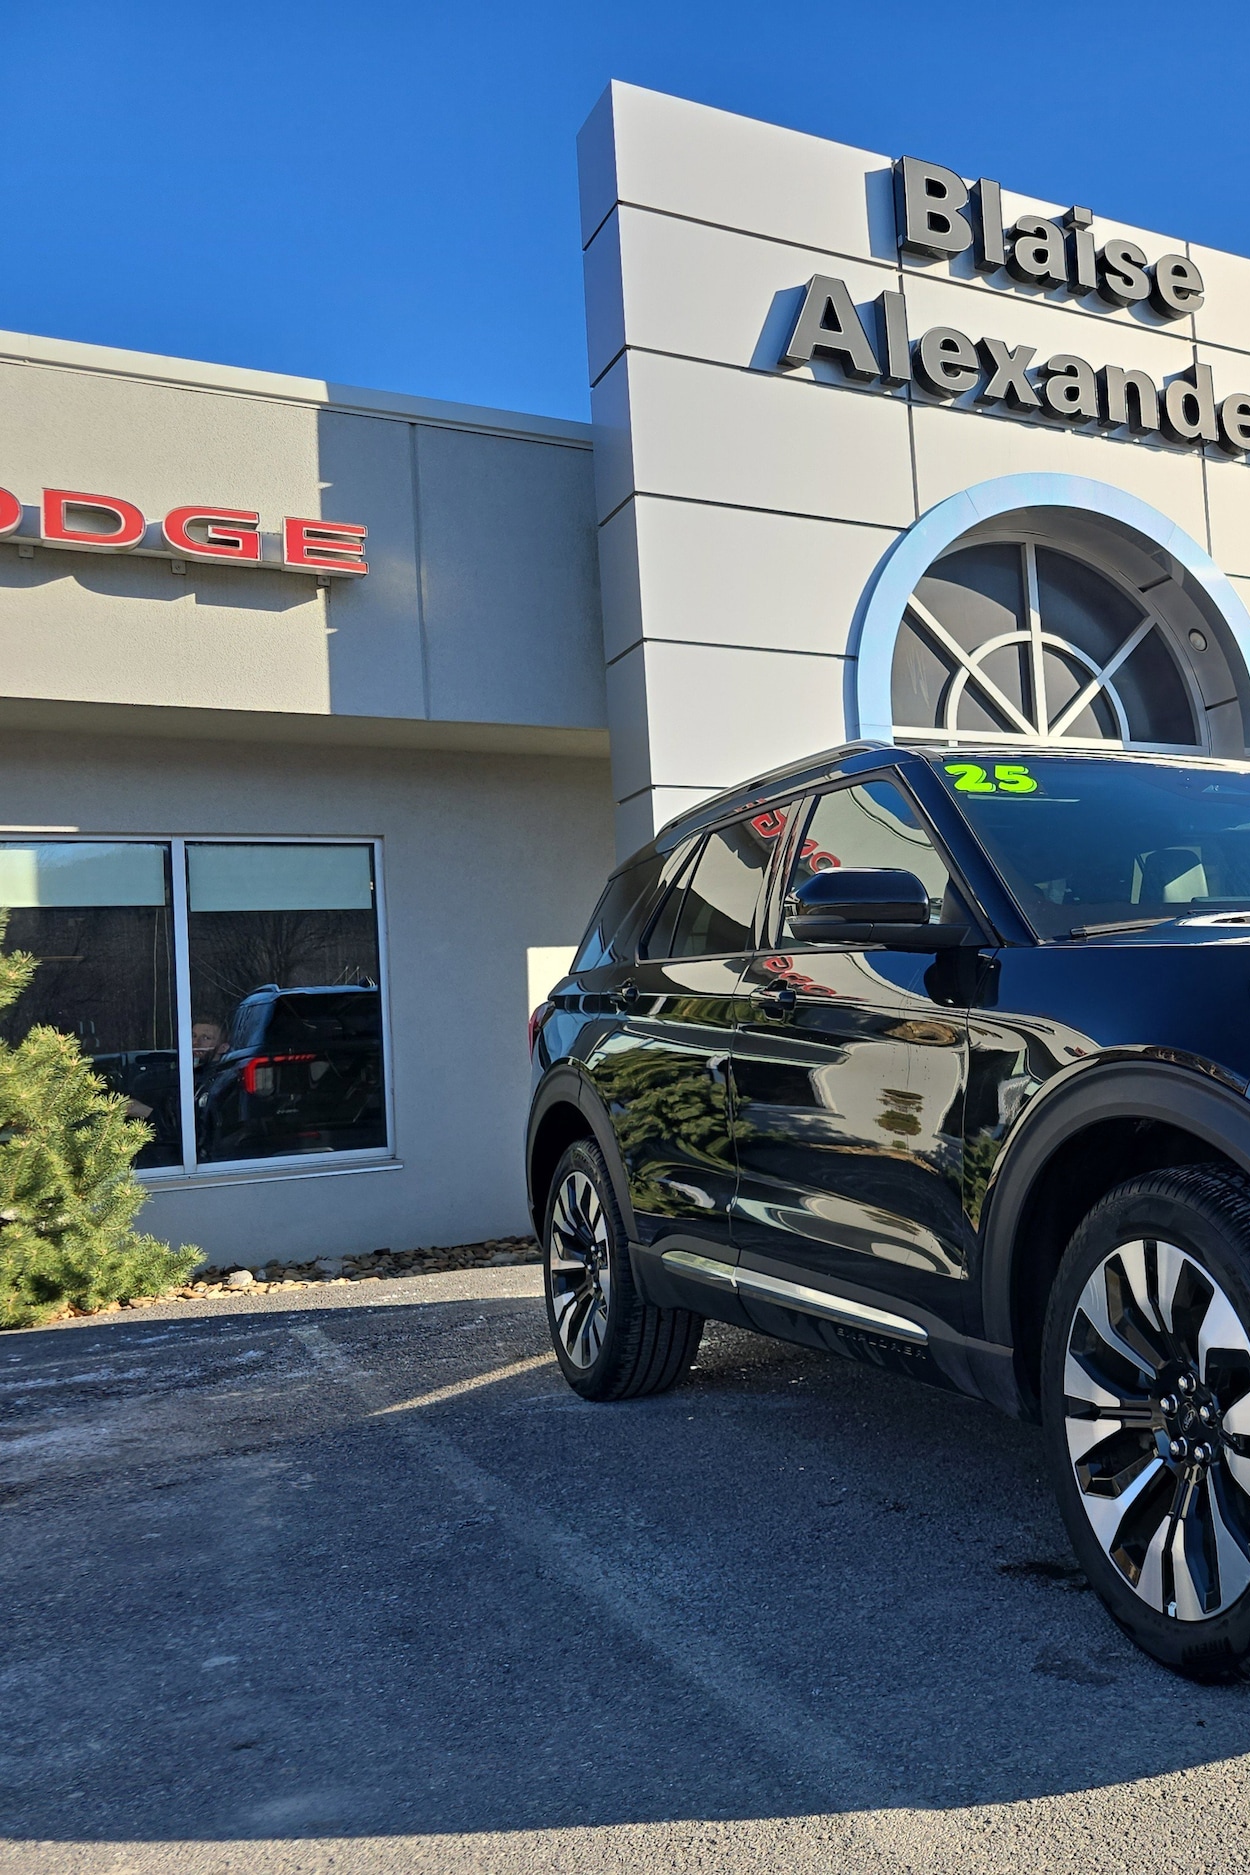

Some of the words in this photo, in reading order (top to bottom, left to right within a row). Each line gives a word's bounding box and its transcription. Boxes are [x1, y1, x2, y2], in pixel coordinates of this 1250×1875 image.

[893, 155, 1205, 321] Blaise
[0, 486, 369, 576] DGE
[943, 764, 1038, 793] 25
